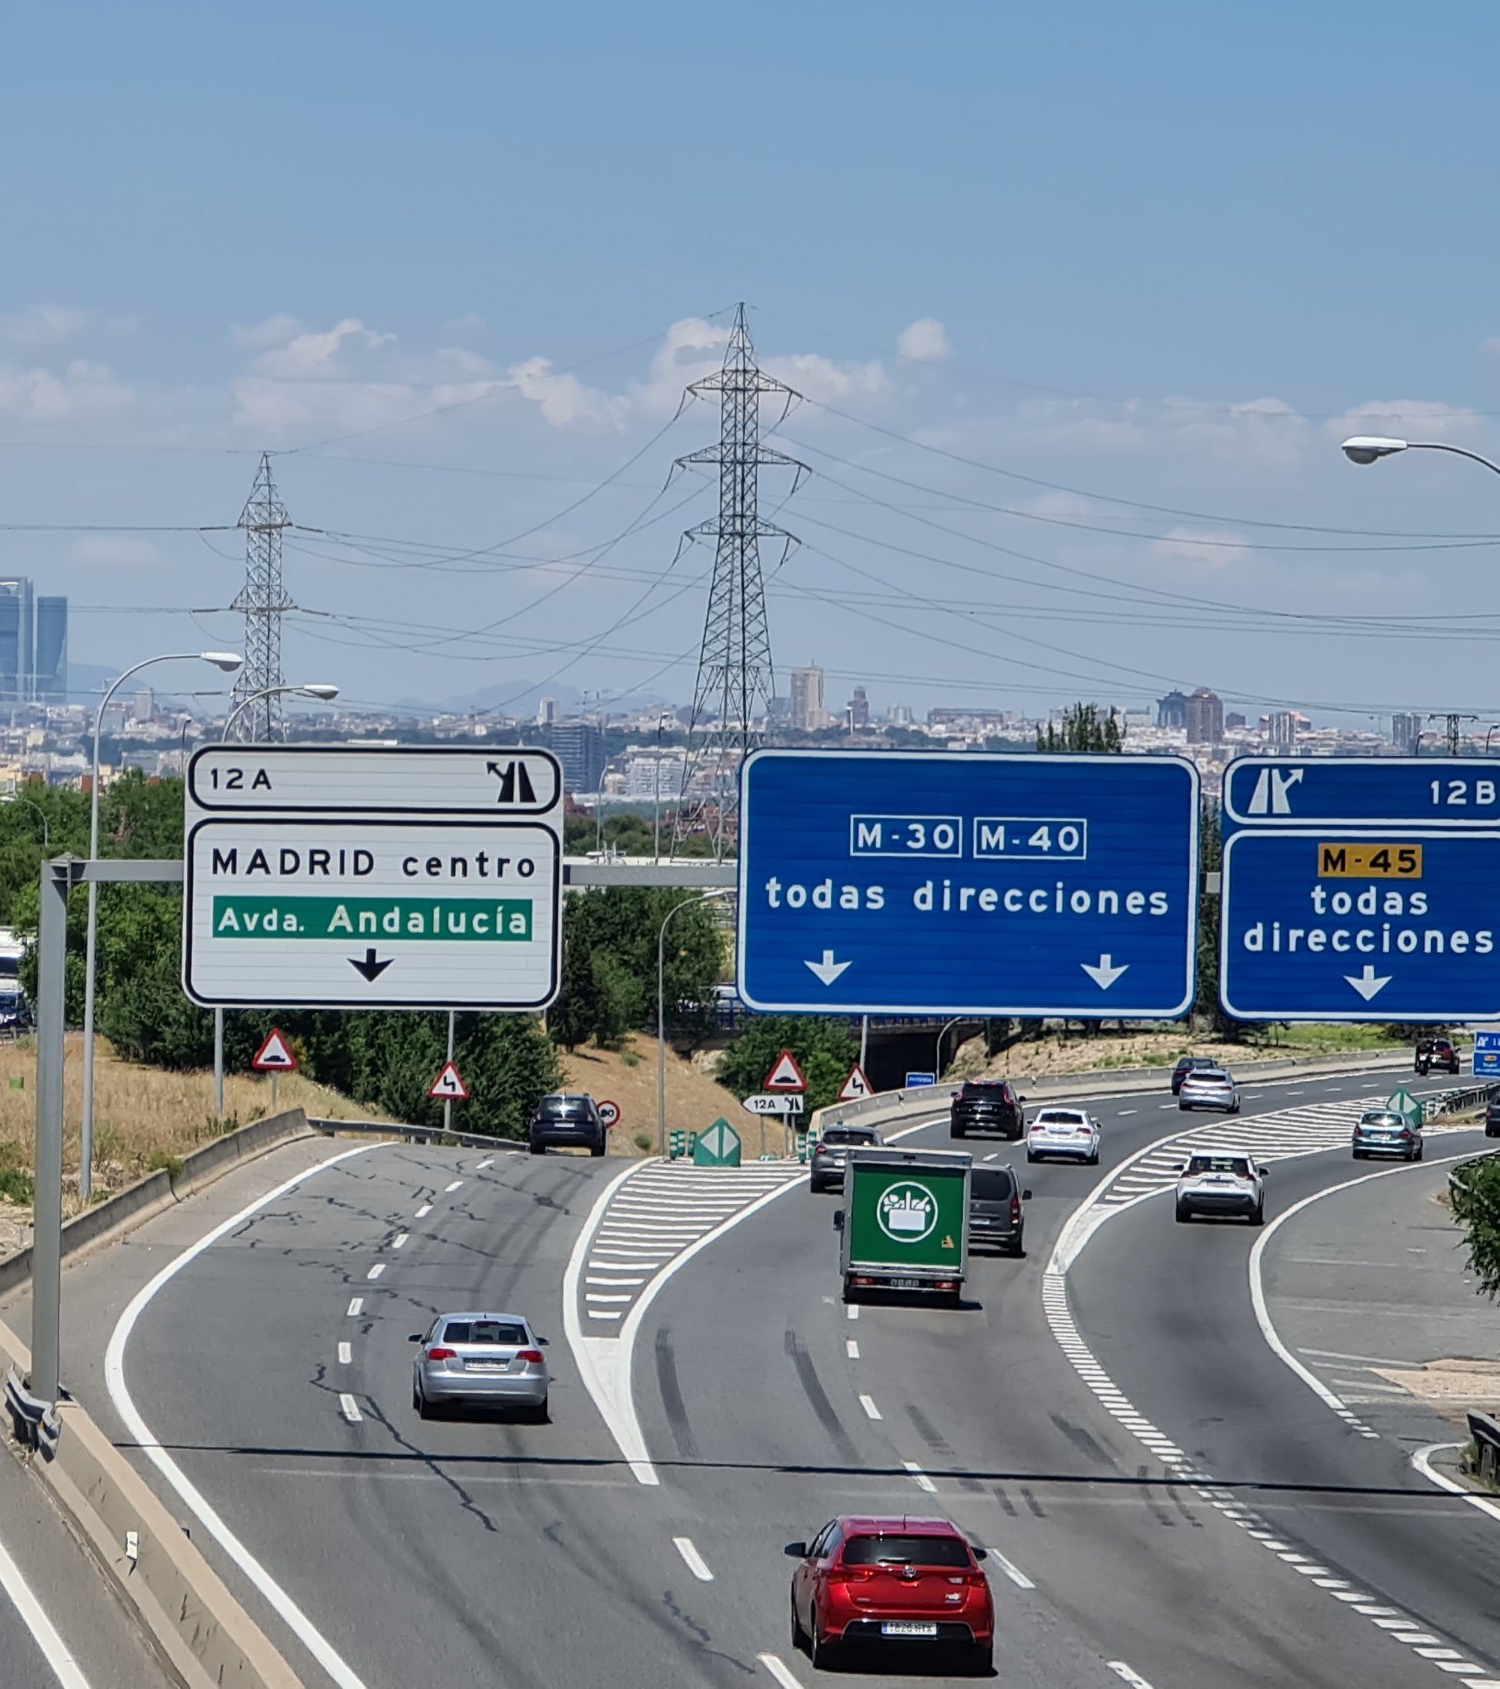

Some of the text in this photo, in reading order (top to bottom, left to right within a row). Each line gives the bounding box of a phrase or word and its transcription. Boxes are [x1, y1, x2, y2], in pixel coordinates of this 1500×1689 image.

[210, 767, 272, 790] 12A
[1430, 780, 1496, 805] 12B
[857, 822, 1079, 852] M-30 M-40
[212, 848, 535, 878] MADRID centro
[1323, 848, 1417, 874] M-45
[765, 876, 1169, 916] todas direcciones
[1310, 884, 1428, 915] todas
[217, 904, 526, 935] Avda. Andalucía
[1243, 921, 1494, 954] direcciones
[753, 1099, 776, 1110] 12A
